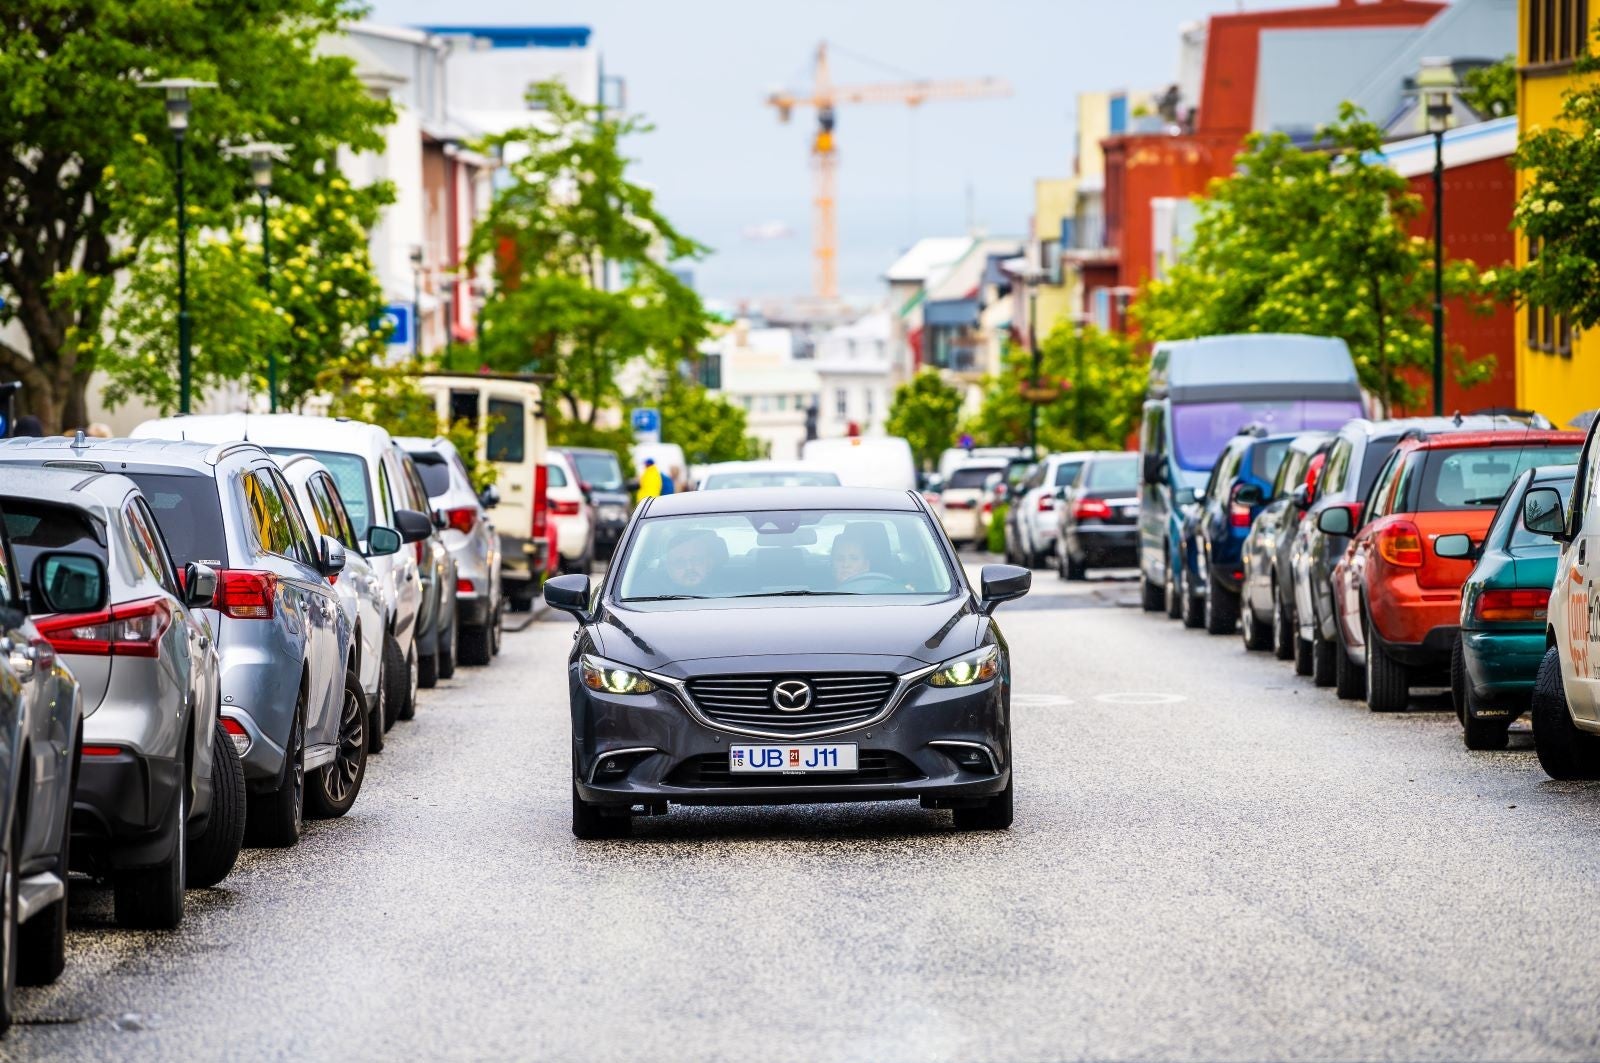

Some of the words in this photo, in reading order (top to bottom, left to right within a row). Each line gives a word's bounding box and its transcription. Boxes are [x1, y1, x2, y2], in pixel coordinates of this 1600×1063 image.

[749, 748, 784, 768] UB
[805, 748, 838, 767] J11
[790, 752, 798, 760] 21
